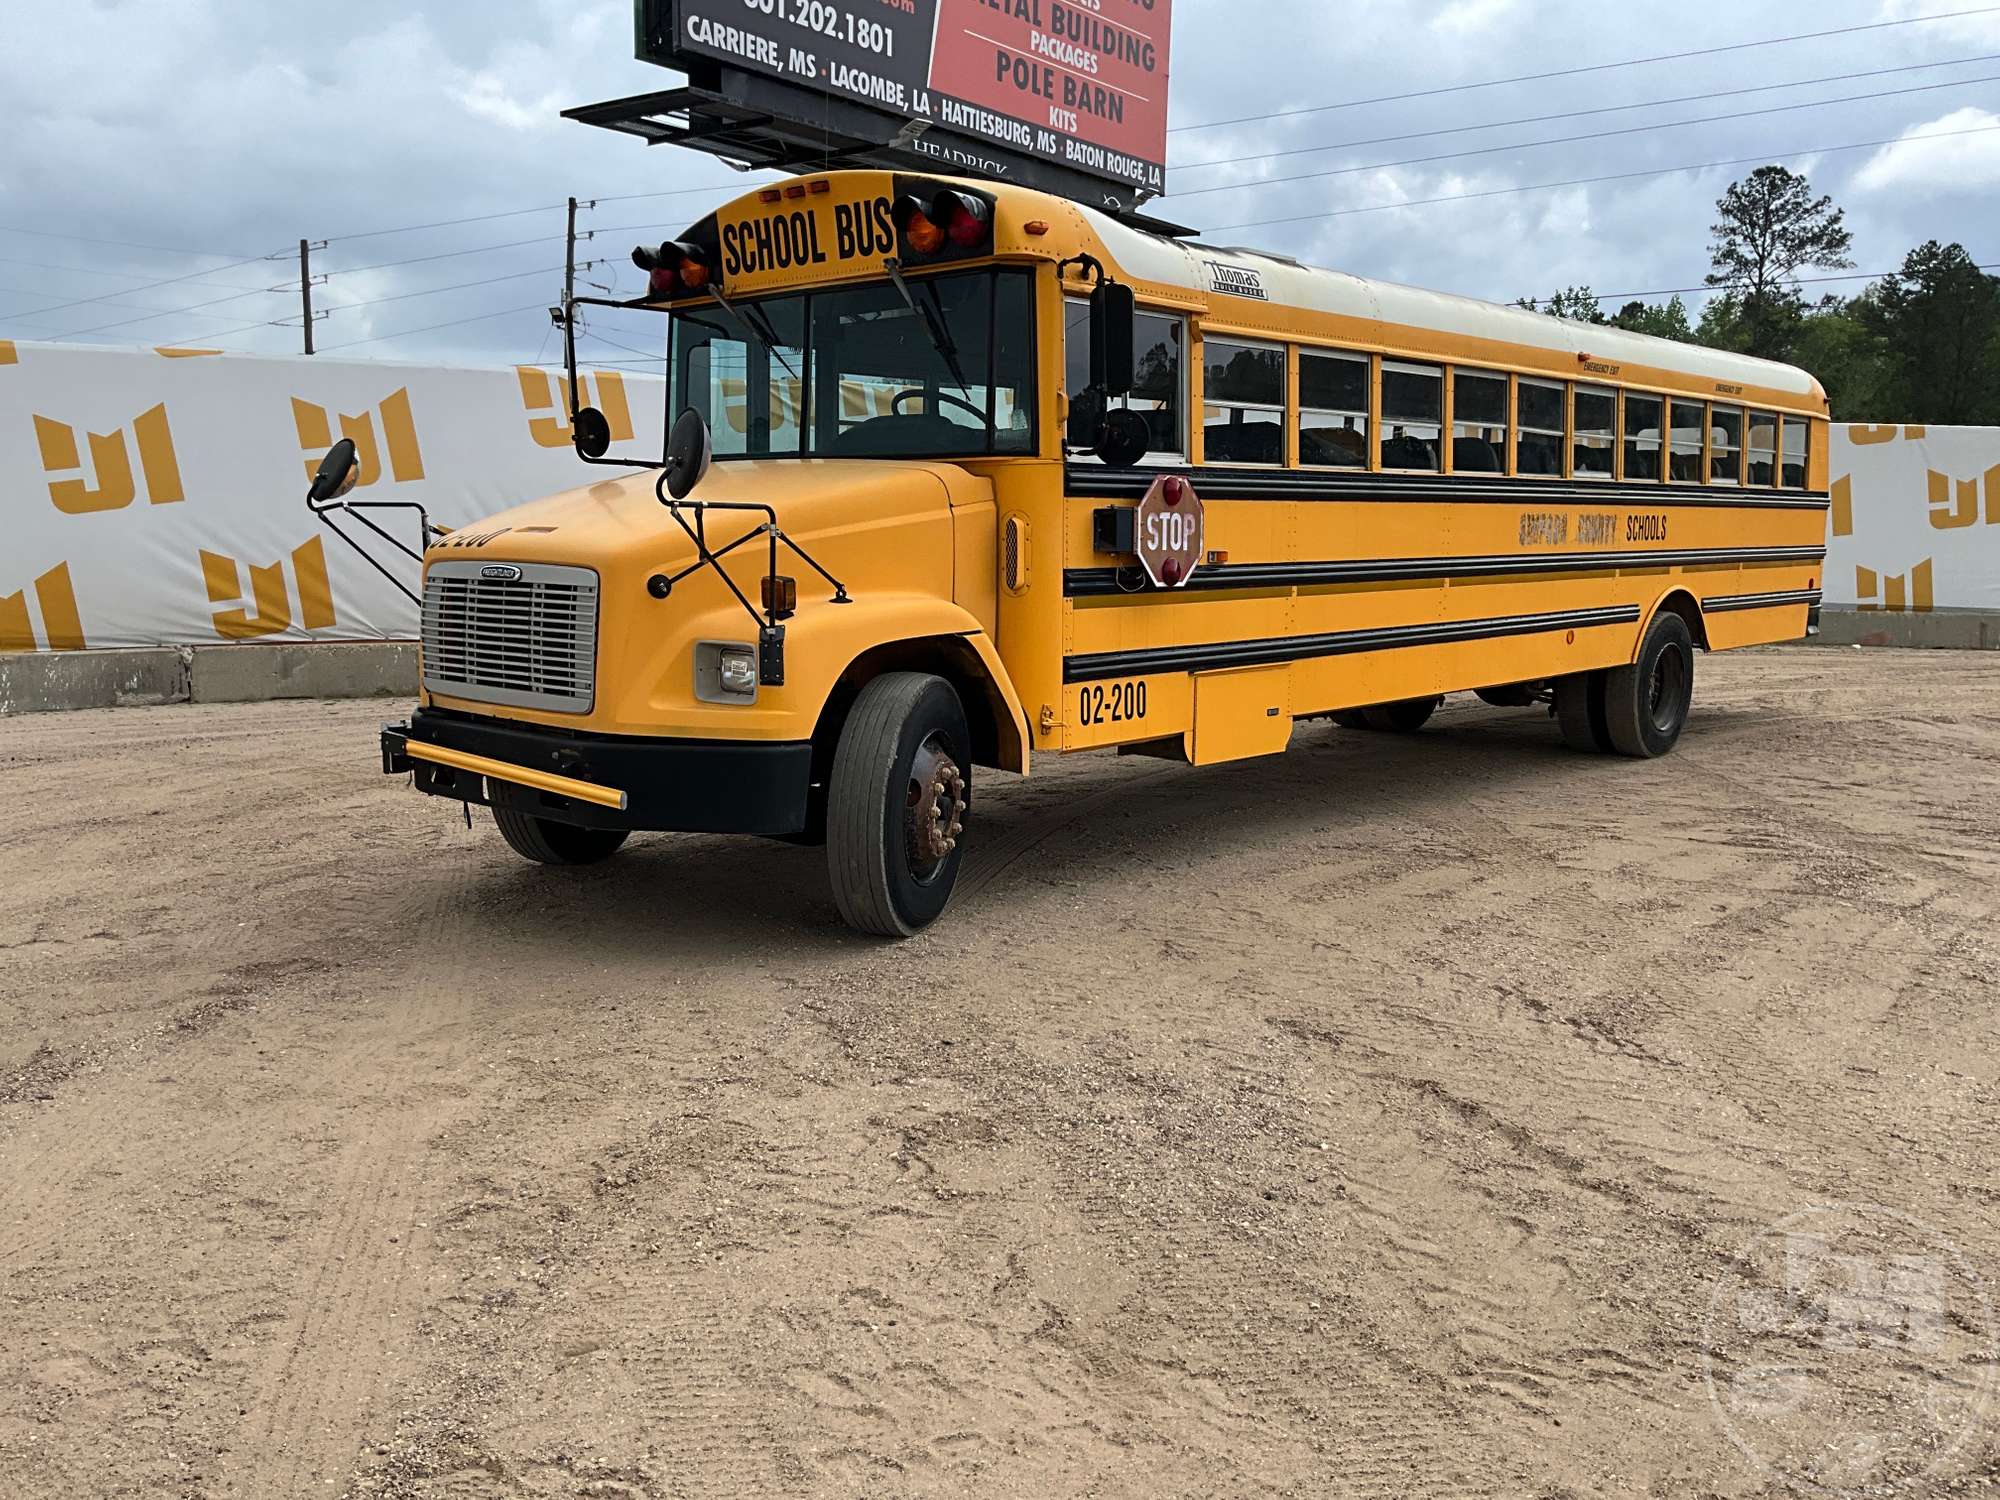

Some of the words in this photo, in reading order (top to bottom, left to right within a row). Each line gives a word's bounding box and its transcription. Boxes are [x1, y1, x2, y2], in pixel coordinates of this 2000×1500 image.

[1030, 30, 1098, 74] PACKAGES
[1051, 4, 1156, 72] BUILDING
[687, 15, 784, 72] CARRIERE,
[788, 48, 816, 78] MS
[830, 61, 909, 112] LACOMBE,
[913, 89, 931, 116] LA
[941, 98, 1034, 151] HATTIESBURG,
[1036, 129, 1056, 154] MS
[1065, 139, 1104, 169] BATON
[1106, 152, 1147, 184] ROUGE,
[1148, 165, 1161, 187] LA
[996, 50, 1054, 100] POLE
[1063, 75, 1124, 124] BARN
[1049, 105, 1078, 133] KITS
[722, 209, 827, 276] SCHOOL
[834, 196, 895, 260] BUS
[1202, 260, 1261, 288] Thomas
[1146, 511, 1196, 551] STOP
[1626, 514, 1667, 542] SCHOOLS
[1080, 680, 1147, 727] 02-200
